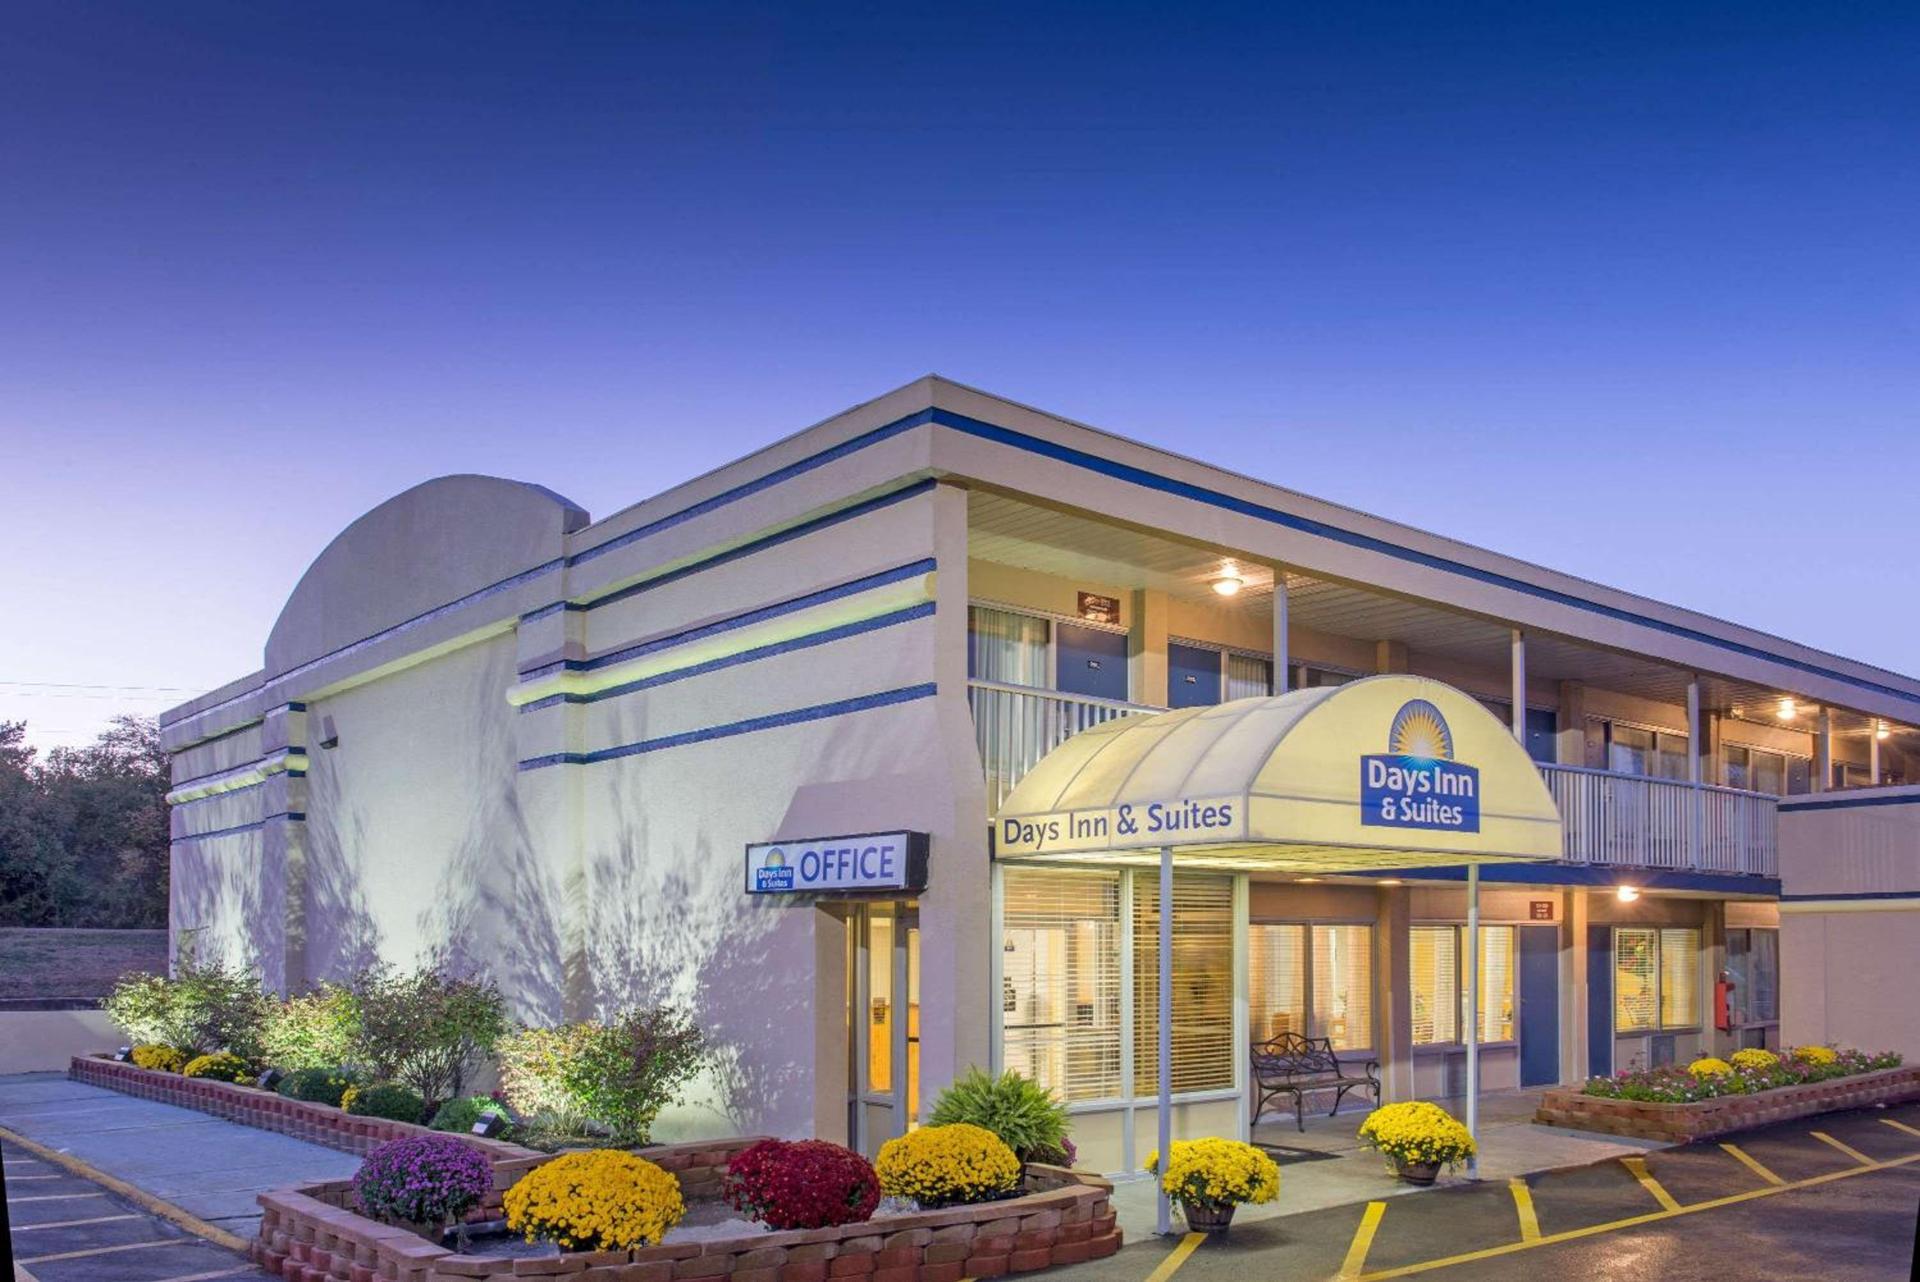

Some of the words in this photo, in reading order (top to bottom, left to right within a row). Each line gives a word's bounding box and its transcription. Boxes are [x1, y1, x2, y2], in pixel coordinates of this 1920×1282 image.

[1368, 759, 1431, 796] Days
[1434, 767, 1473, 797] Inn
[1004, 818, 1059, 850] Days
[1069, 812, 1107, 839] Inn
[1117, 804, 1138, 835] &
[1147, 800, 1232, 832] Suites
[1381, 797, 1396, 820] &
[1400, 797, 1463, 825] Suites
[801, 846, 894, 882] OFFICE
